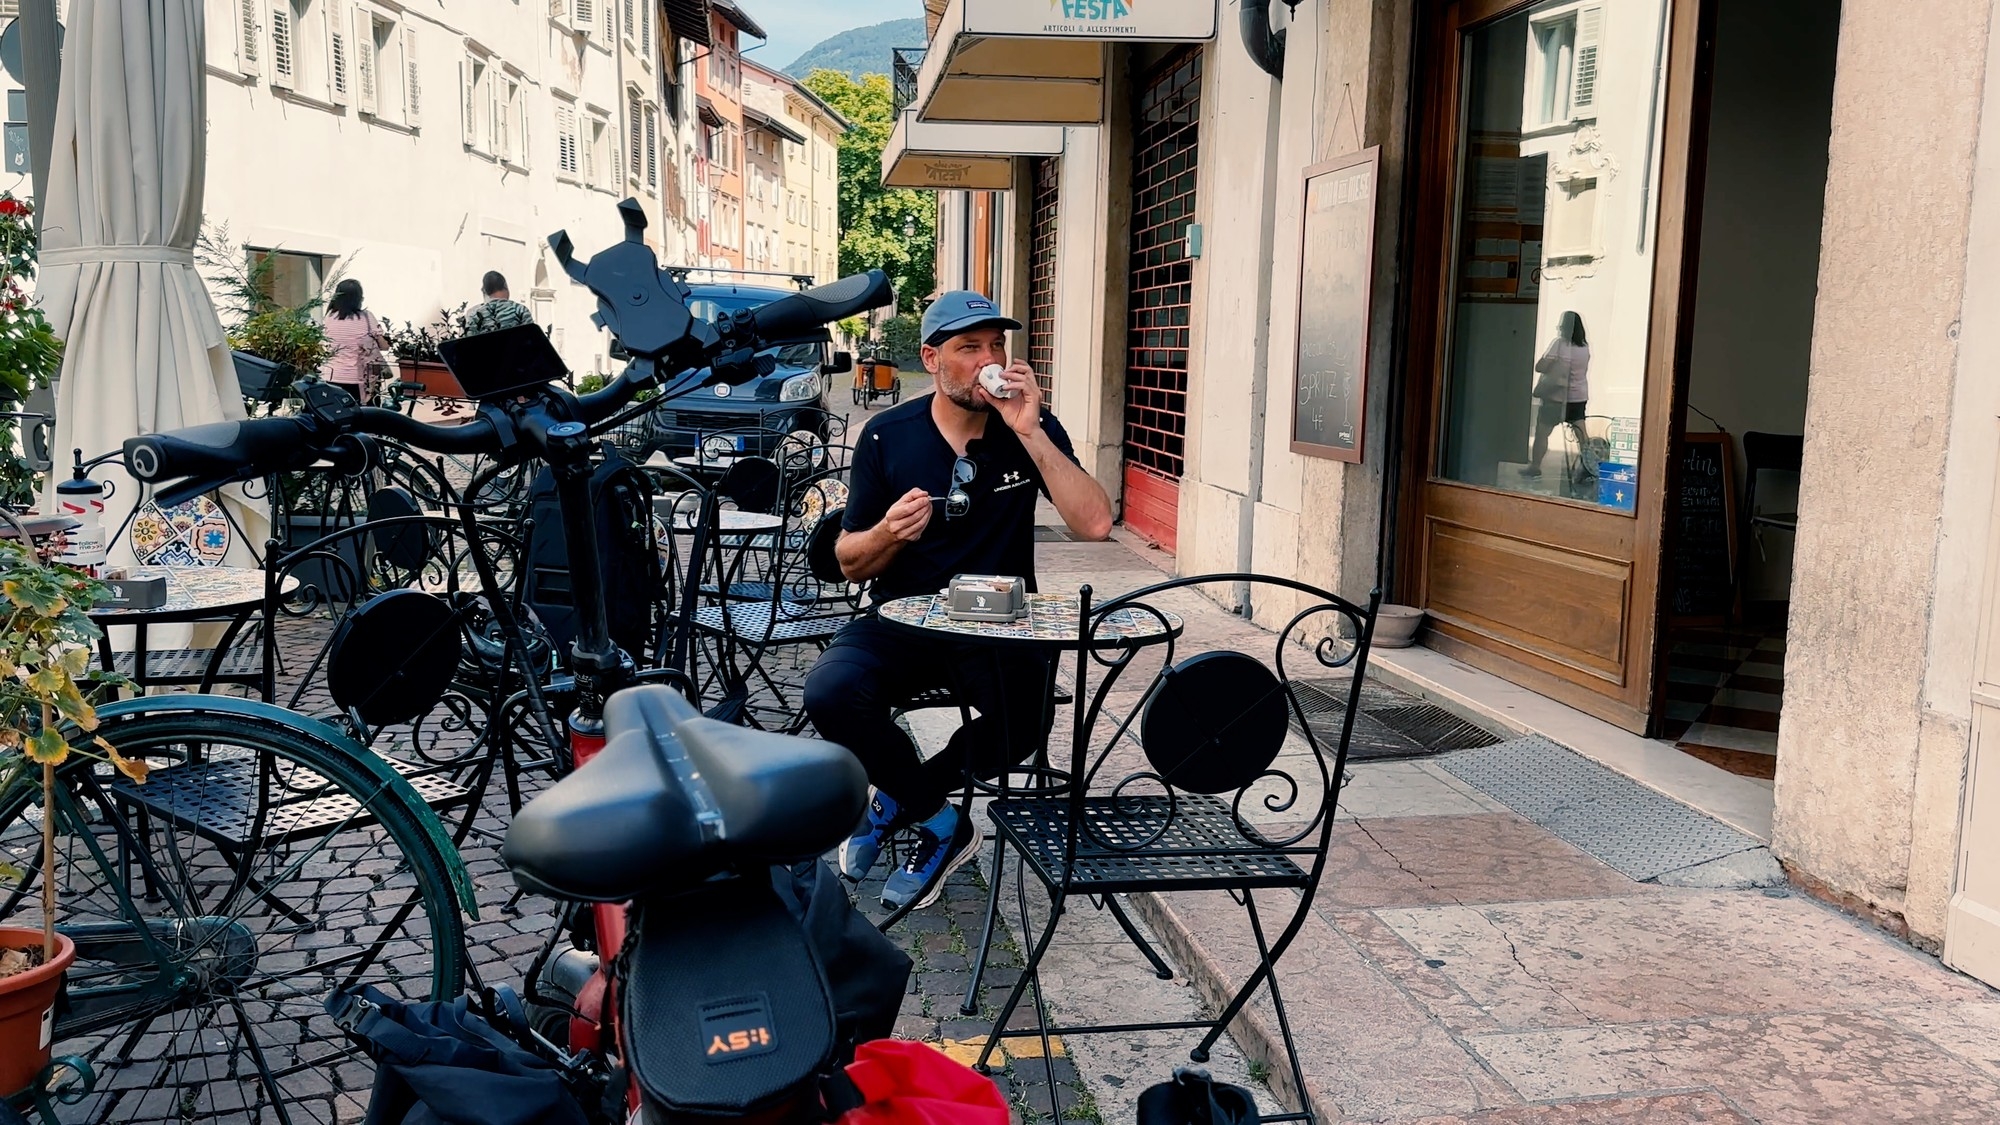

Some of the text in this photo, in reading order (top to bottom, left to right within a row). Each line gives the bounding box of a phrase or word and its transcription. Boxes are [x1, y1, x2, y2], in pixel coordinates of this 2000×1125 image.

[1062, 0, 1129, 20] FESTA
[1299, 369, 1337, 405] SPRITZ
[993, 484, 1012, 492] UNDER
